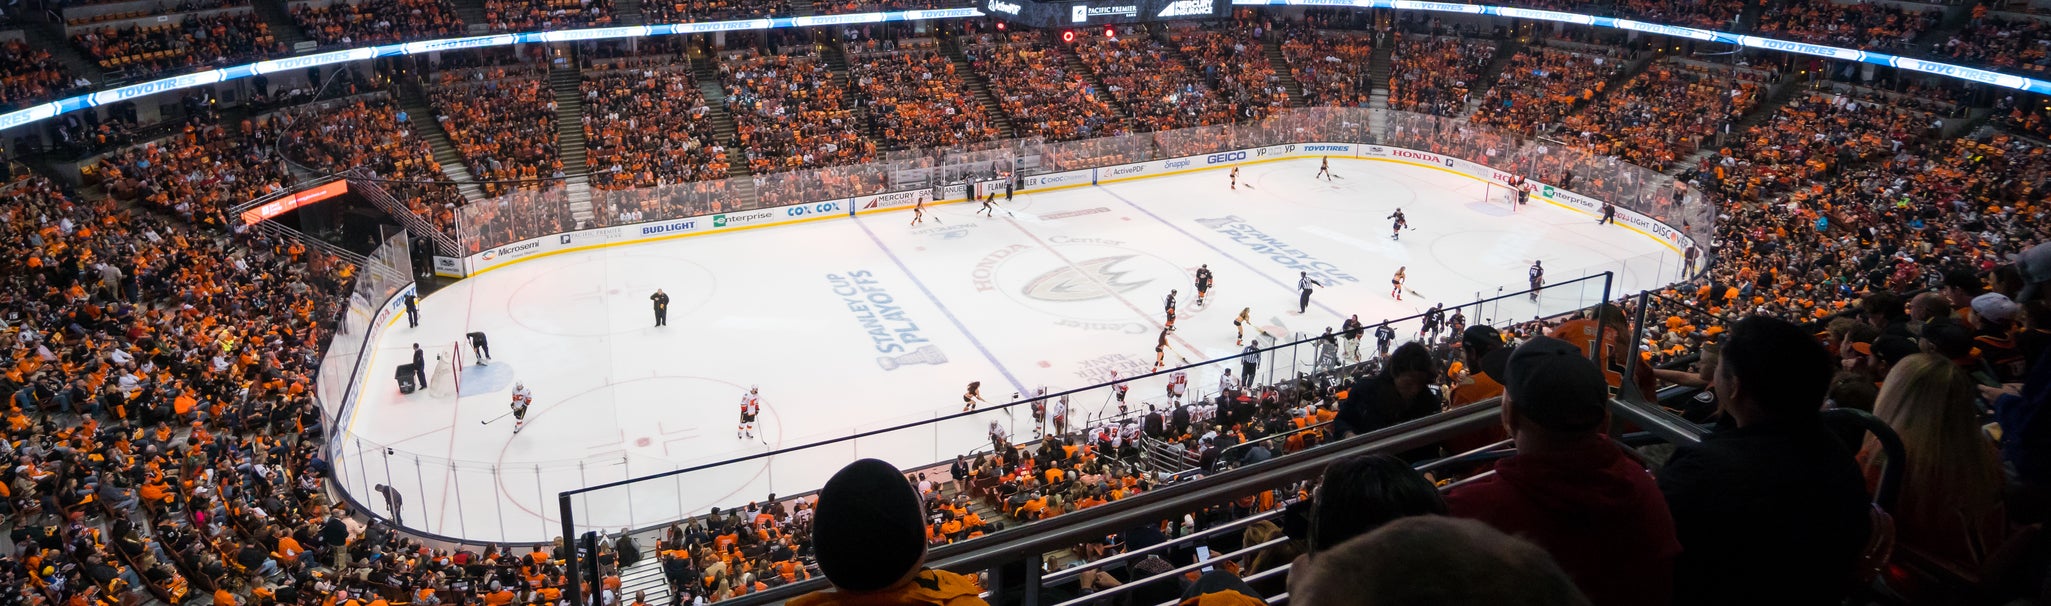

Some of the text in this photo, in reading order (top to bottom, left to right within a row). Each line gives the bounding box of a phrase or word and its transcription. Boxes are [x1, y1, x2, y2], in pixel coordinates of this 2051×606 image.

[921, 9, 973, 19] TOYO TIRES
[1111, 5, 1137, 13] PREMIER
[1175, 6, 1213, 15] INSURANCE
[1515, 10, 1575, 20] TOYO TIRES
[811, 14, 868, 25] TOYO TIRES
[692, 21, 751, 32] TOYO TIRES
[1633, 22, 1693, 36] TOYO TIRES
[563, 28, 629, 40] TOYO TIRES
[458, 37, 494, 48] TIRES
[1762, 40, 1837, 56] TOYO TIRES
[276, 50, 351, 70] TOYO TIRES
[1917, 61, 2000, 83] TOYO TIRES
[116, 75, 197, 98] TOYO TIRES
[1256, 147, 1267, 156] yp
[1284, 144, 1296, 154] yp
[1207, 150, 1247, 165] GEICO
[1392, 149, 1441, 164] HONDA
[1163, 158, 1191, 169] Snapple
[1113, 165, 1144, 176] ActivePDF
[1047, 175, 1064, 183] CHOC
[1493, 172, 1539, 192] HODA
[878, 192, 915, 202] MERCURY
[918, 188, 934, 197] SAN
[1548, 188, 1595, 209] enterprise
[787, 202, 841, 217] COX COX
[878, 199, 915, 208] INSURANCE
[717, 211, 773, 224] enterprise
[1630, 217, 1650, 229] LIGHT
[570, 228, 622, 240] PACIFIC PREMIER
[642, 221, 696, 236] BUD LIGHT
[1048, 234, 1128, 247] Center
[1653, 223, 1689, 249] DISCOVER
[498, 240, 540, 257] Microsemi
[1230, 222, 1360, 283] STANLEY CUP
[971, 244, 1032, 294] HONDA
[826, 273, 905, 353] STANLEY CUP
[848, 269, 930, 345] PLAYOFFS
